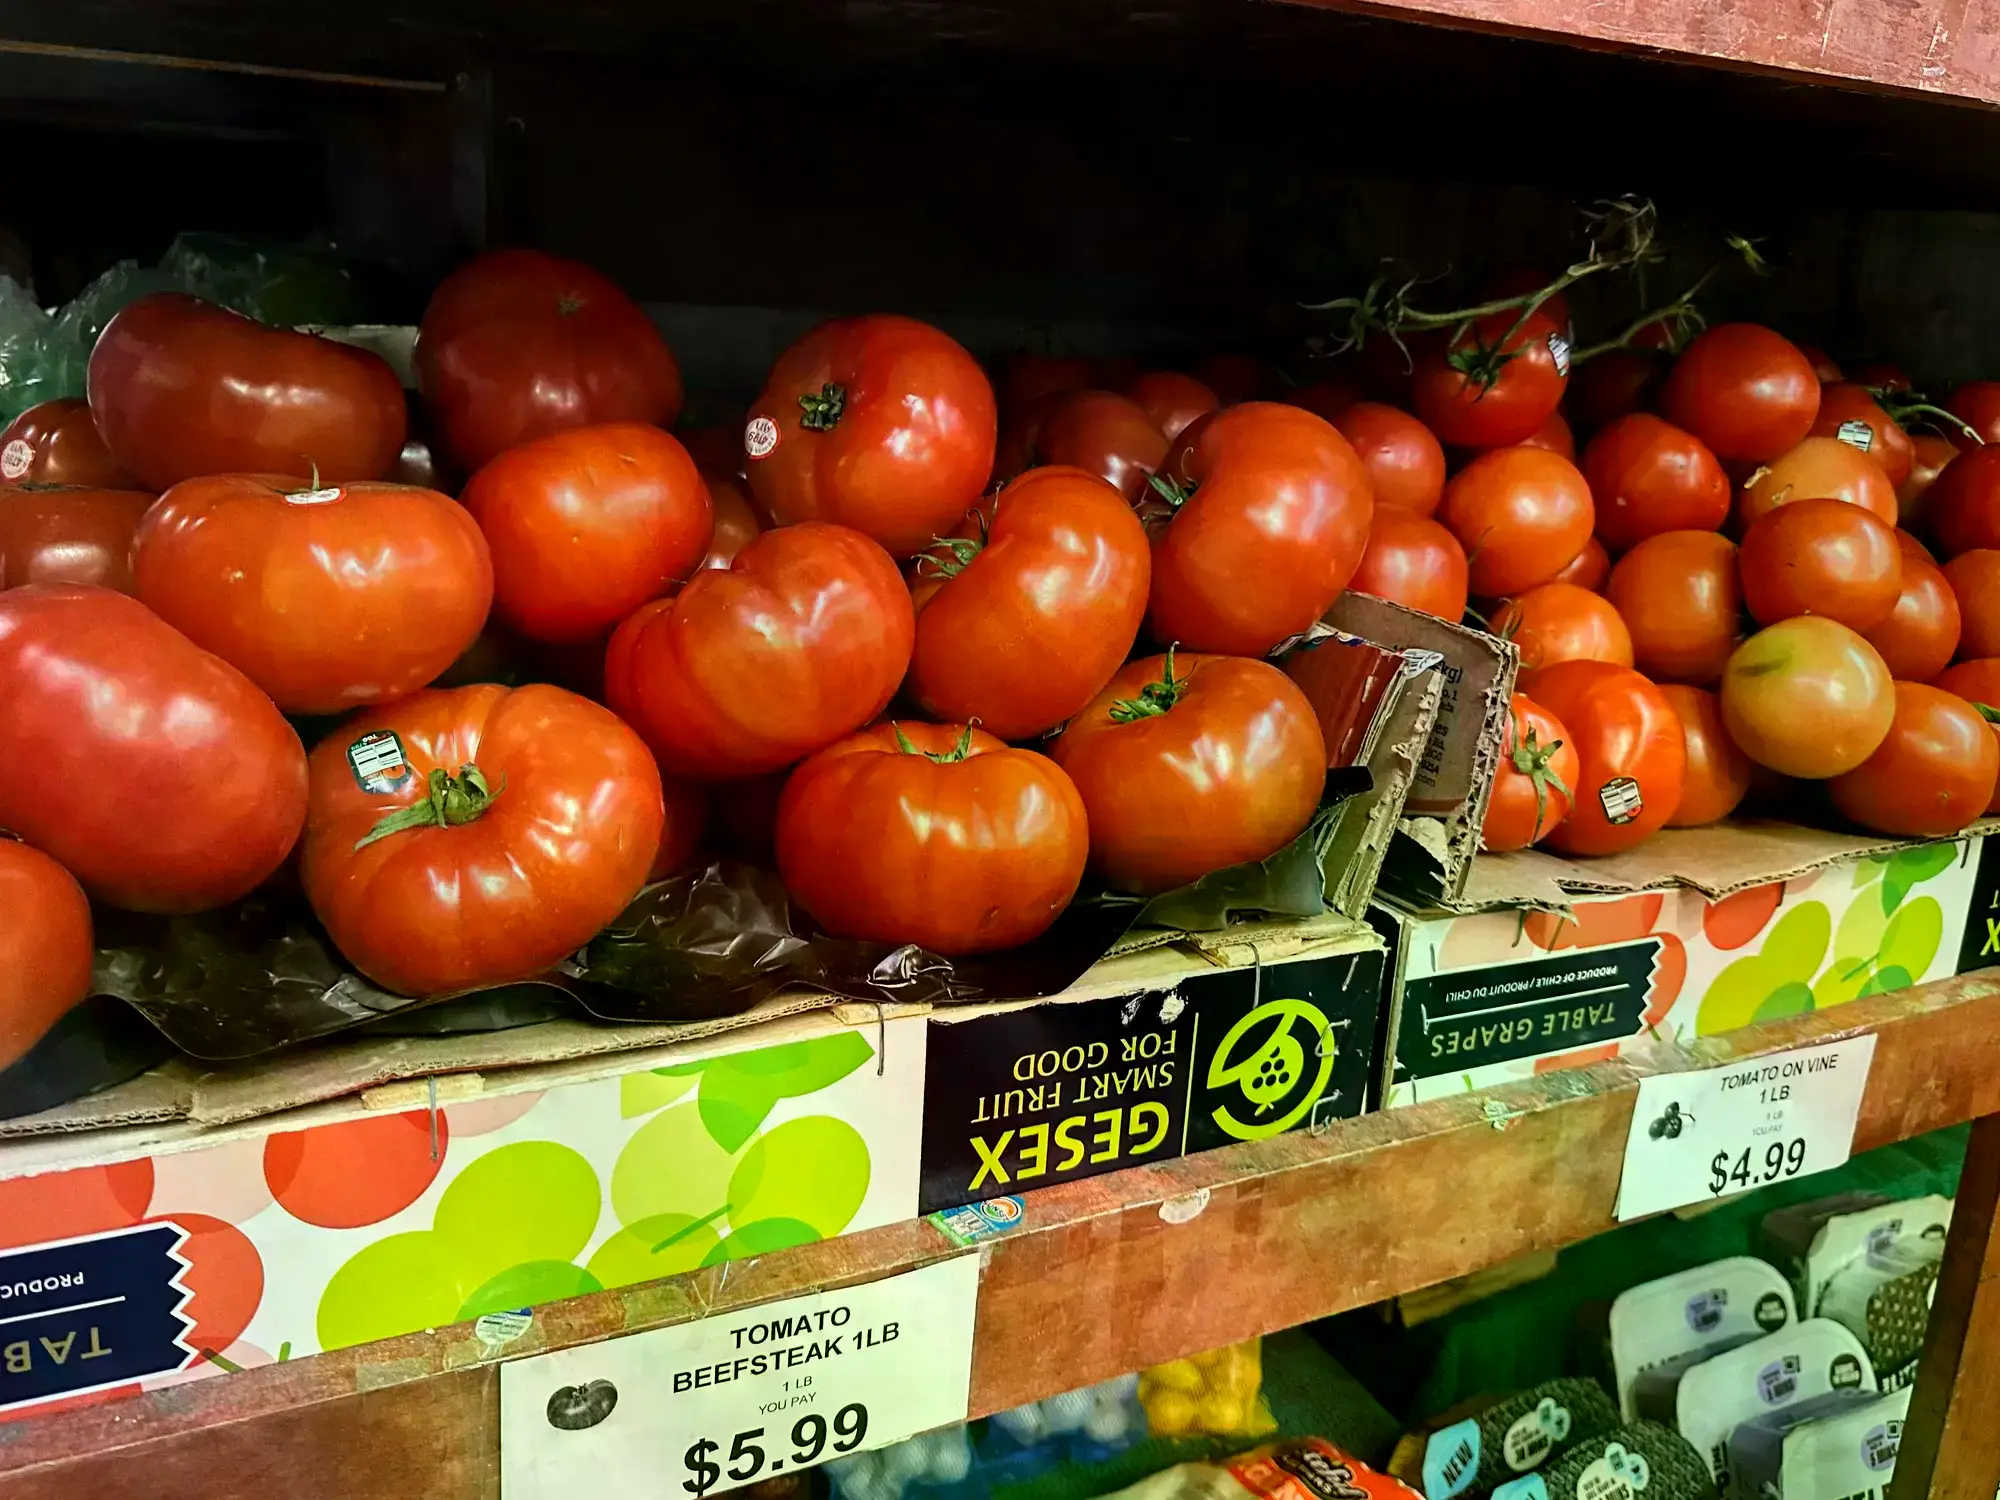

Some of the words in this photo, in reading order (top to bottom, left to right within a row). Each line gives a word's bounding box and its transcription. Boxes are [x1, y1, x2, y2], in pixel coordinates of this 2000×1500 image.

[1488, 980, 1530, 995] PRODUIT
[1535, 975, 1562, 987] CHILE
[1563, 974, 1576, 982] OF
[1576, 965, 1618, 977] PRODUCE
[1472, 988, 1487, 998] DU
[1431, 1018, 1535, 1058] GRAPES
[1541, 1002, 1616, 1037] TABLE
[1013, 1042, 1109, 1082] GOOD
[1121, 1030, 1177, 1062] FOR
[1072, 1061, 1175, 1103] SMART
[1720, 1065, 1779, 1092] TOMATO
[1782, 1060, 1804, 1077] ON
[1807, 1053, 1839, 1074] VINE
[970, 1082, 1062, 1124] FRUIT
[1760, 1088, 1766, 1104] 1
[1770, 1085, 1790, 1102] LB
[967, 1101, 1170, 1192] GESEX
[1708, 1136, 1807, 1198] $4.99
[730, 1306, 851, 1349] TOMATO
[673, 1336, 844, 1394] BEEFSTEAK
[852, 1321, 900, 1351] 1LB
[782, 1381, 789, 1392] 1
[796, 1375, 813, 1389] LB
[758, 1399, 787, 1415] YOU
[790, 1392, 817, 1407] PAY
[682, 1402, 869, 1498] $5.99
